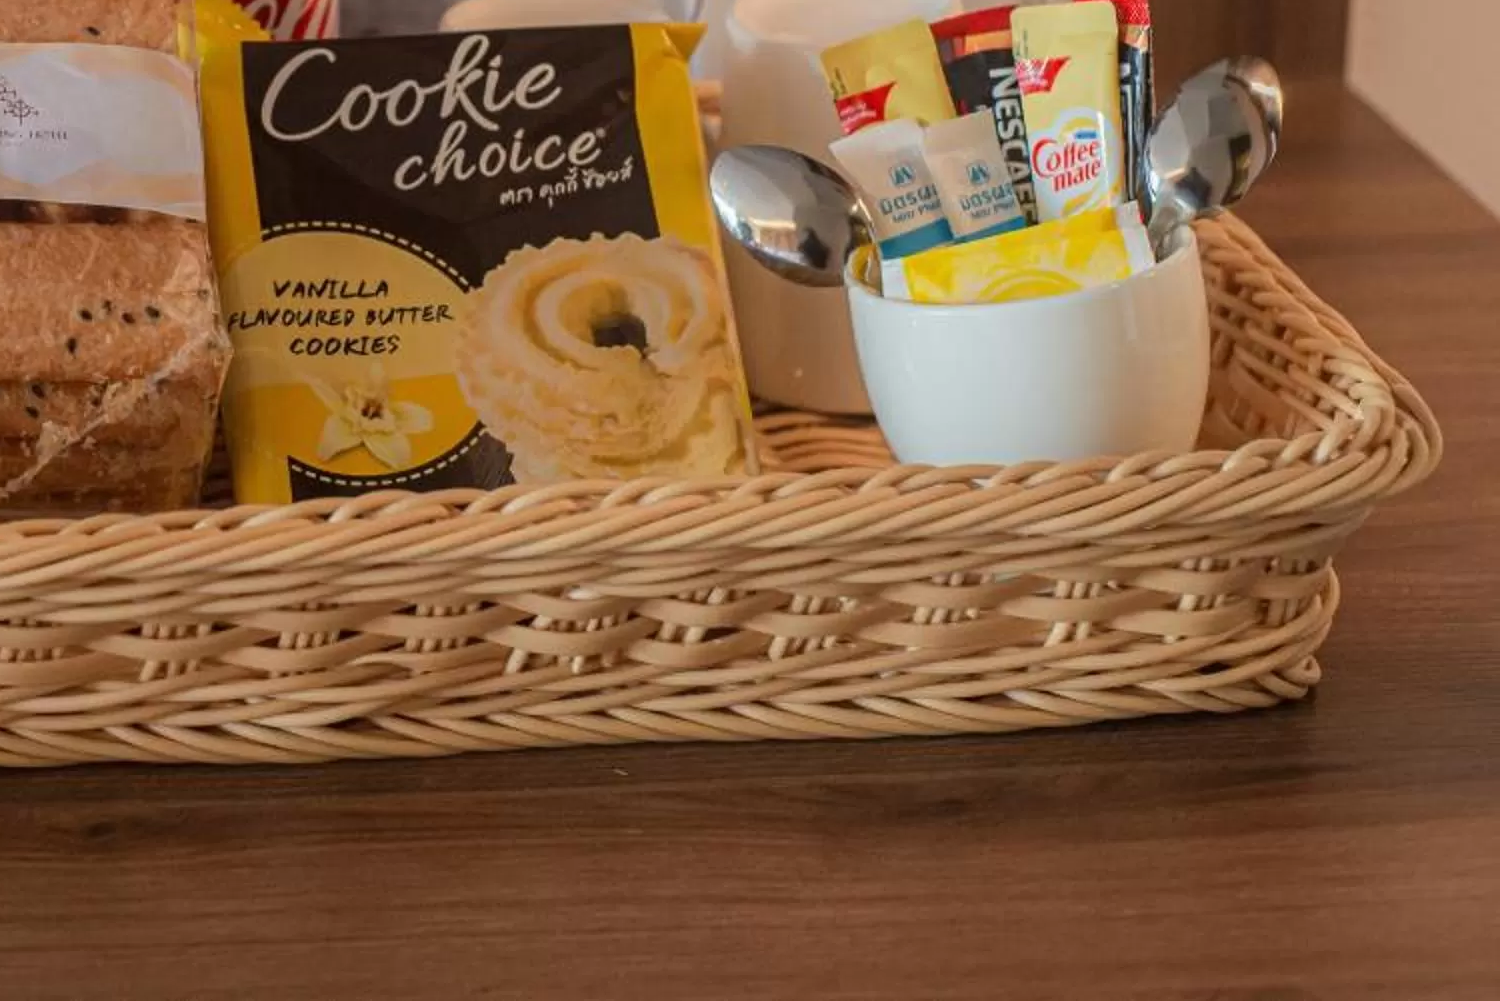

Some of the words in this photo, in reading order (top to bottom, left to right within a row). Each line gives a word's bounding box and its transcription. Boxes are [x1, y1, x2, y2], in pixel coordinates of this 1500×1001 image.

[261, 33, 562, 141] Cookie
[394, 120, 602, 191] choice
[1032, 137, 1101, 178] Coffee
[1052, 159, 1101, 192] mate
[273, 279, 389, 299] VANILLA
[227, 308, 355, 332] FLAVOURED
[365, 303, 454, 326] BUTTER
[289, 334, 400, 356] COOKIES
